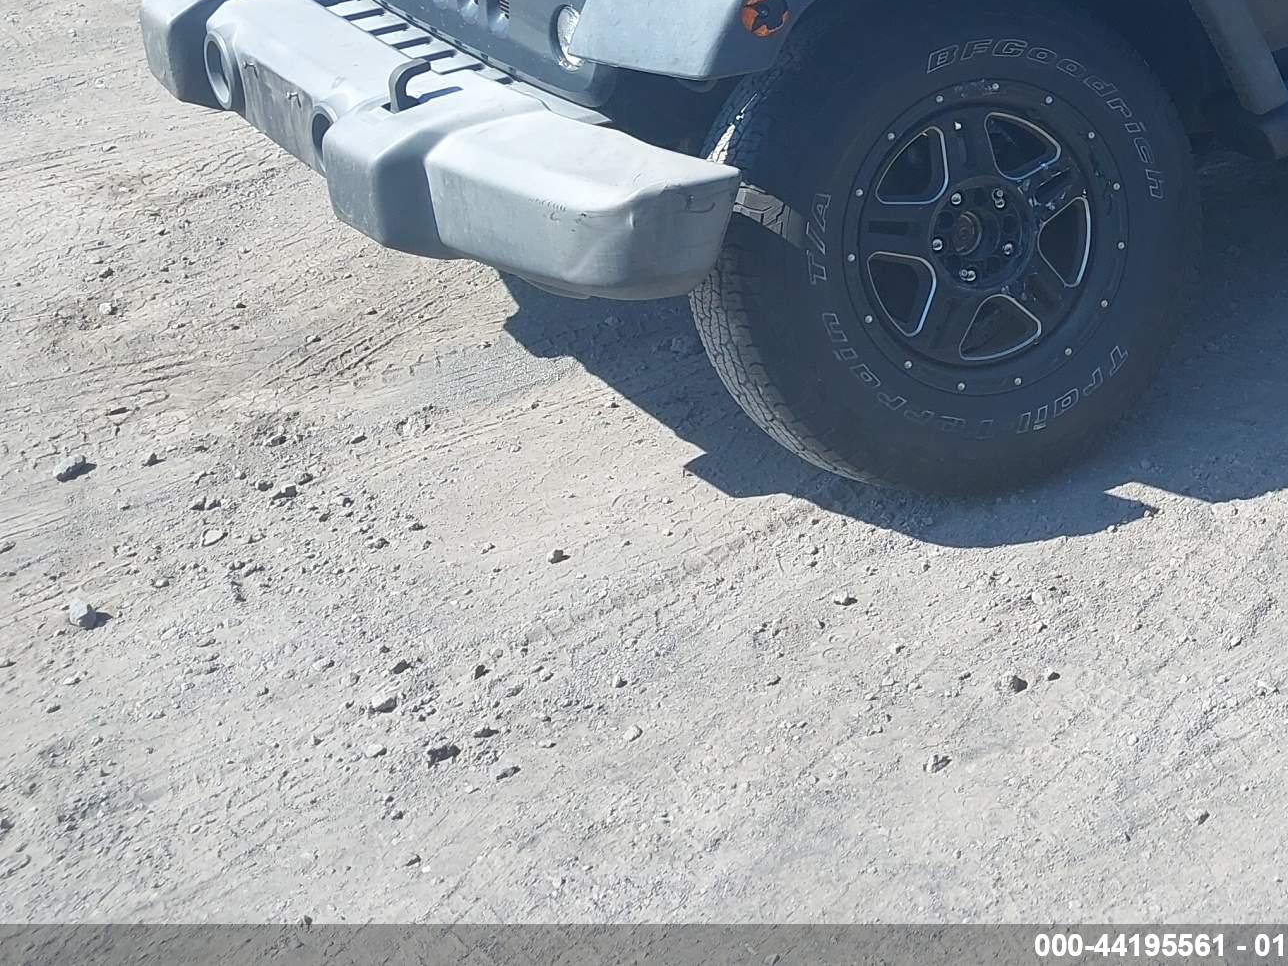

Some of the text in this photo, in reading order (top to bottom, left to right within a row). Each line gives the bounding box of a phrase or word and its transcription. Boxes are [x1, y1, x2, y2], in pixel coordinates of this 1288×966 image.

[926, 37, 1167, 202] BFGoodrich
[806, 192, 832, 286] T/A
[1015, 344, 1130, 435] Trail
